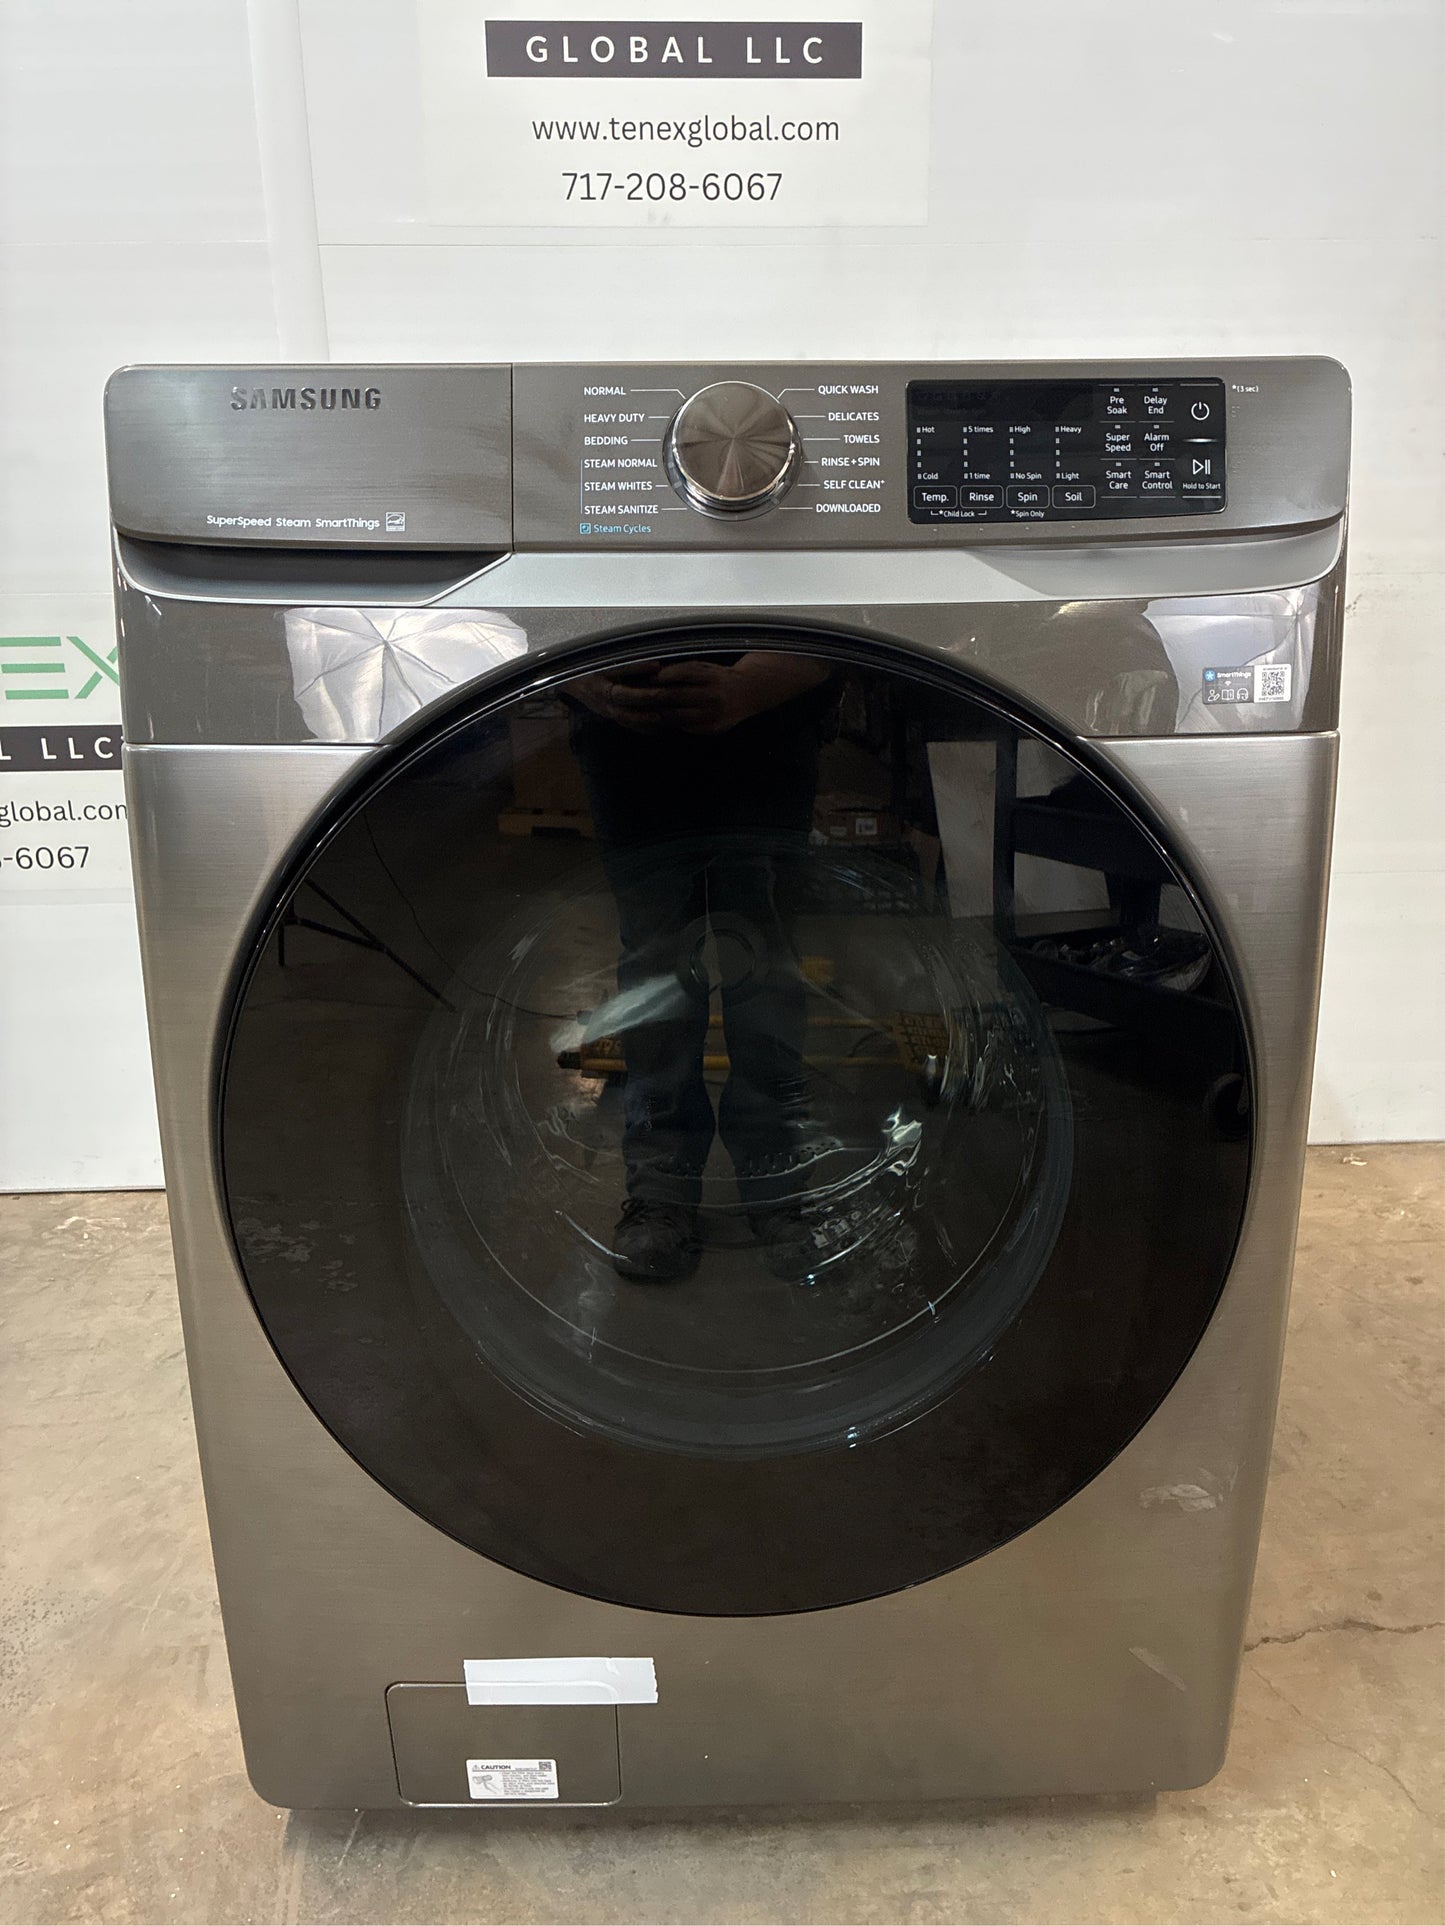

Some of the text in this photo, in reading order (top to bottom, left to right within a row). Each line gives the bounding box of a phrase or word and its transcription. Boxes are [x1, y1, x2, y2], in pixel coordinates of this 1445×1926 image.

[526, 36, 824, 64] GLOBAL LLC
[532, 115, 840, 148] www.tenexglobal.com
[562, 172, 783, 201] 717-208-6067
[583, 386, 626, 396] NORMAL
[818, 385, 879, 395] QUICK WASH
[230, 386, 382, 411] SAMSUNG
[1110, 396, 1125, 404] Pre
[1144, 396, 1168, 406] Delay
[1107, 406, 1128, 415] Soak
[1148, 406, 1164, 414] End
[584, 413, 645, 423] HEAVY DUTY
[828, 412, 880, 421] DELICATES
[1014, 426, 1031, 434] High
[1060, 425, 1082, 434] Heavy
[584, 436, 628, 445] BEDDING
[843, 434, 880, 444] TOWELS
[1106, 433, 1130, 442] Super
[1144, 433, 1169, 441] Alarm
[1105, 443, 1132, 453] Speed
[1150, 443, 1165, 452] Off
[584, 459, 657, 468] STEAM NORMAL
[1061, 472, 1079, 481] Light
[1106, 470, 1132, 479] Smart
[1144, 470, 1170, 479] Smart
[584, 482, 652, 491] STEAM WHITES
[823, 480, 847, 489] SELF
[1109, 481, 1129, 490] Care
[1142, 481, 1173, 490] Control
[921, 492, 949, 503] Temp.
[969, 492, 994, 501] Rinse
[1017, 492, 1038, 503] Spin
[1065, 491, 1082, 502] Soil
[584, 505, 659, 515] STEAM SANITIZE
[816, 504, 881, 513] DOWNLOADED
[1030, 510, 1045, 518] Only
[206, 515, 272, 528] SuperSpeed
[275, 518, 311, 528] Steam
[315, 518, 380, 531] SmartThings
[594, 524, 651, 534] Steam Cycles
[41, 737, 114, 760] LLC
[0, 846, 89, 869] -6067
